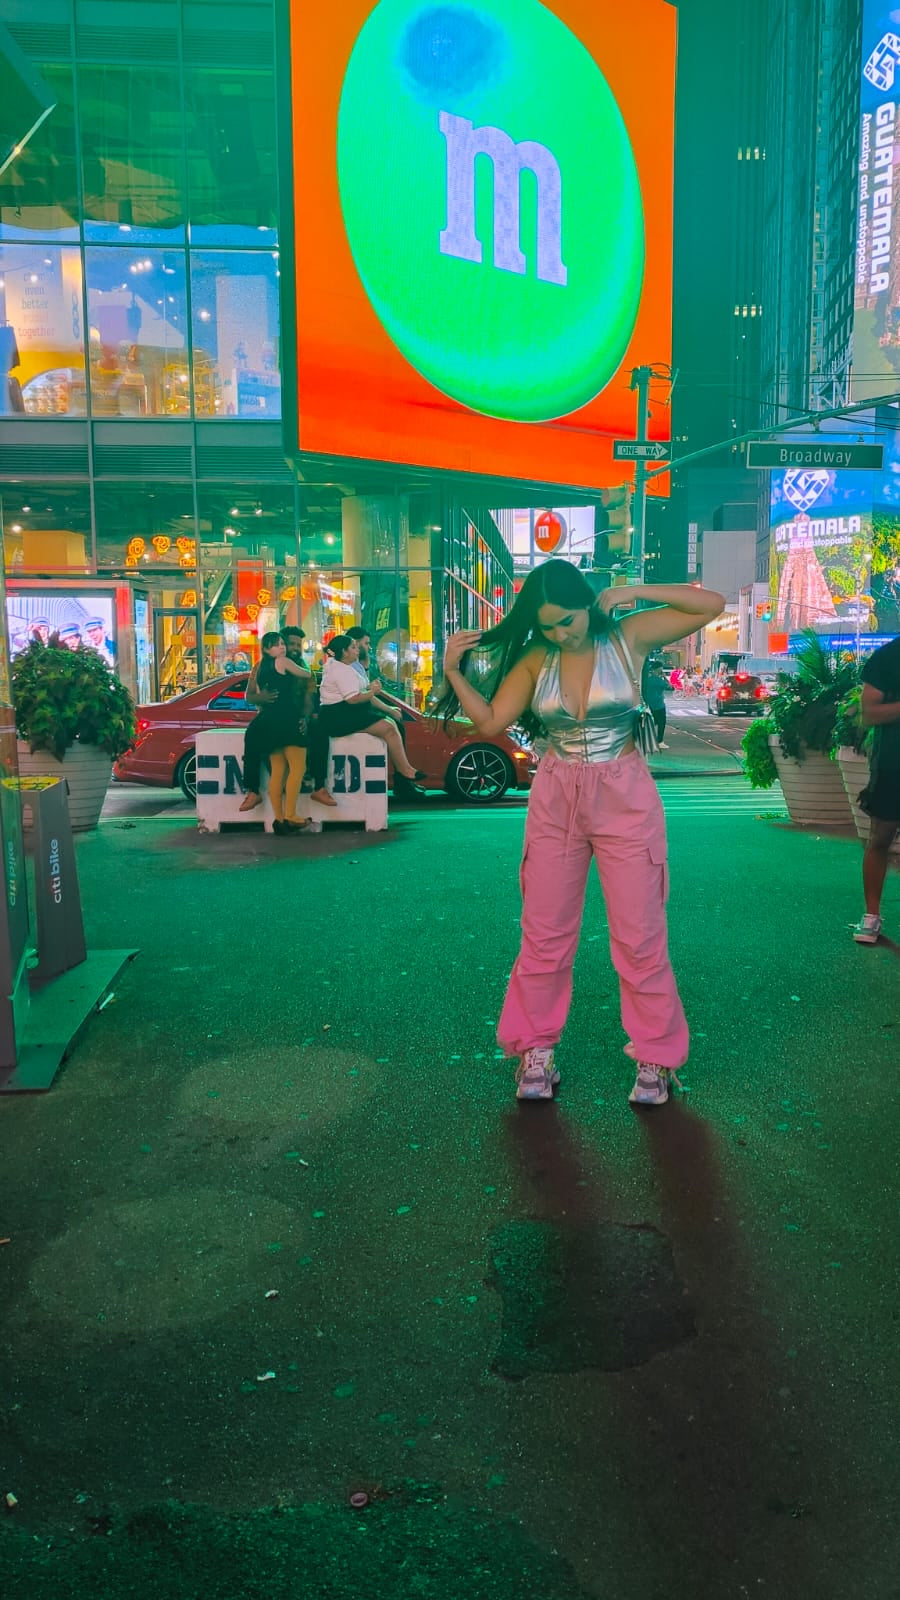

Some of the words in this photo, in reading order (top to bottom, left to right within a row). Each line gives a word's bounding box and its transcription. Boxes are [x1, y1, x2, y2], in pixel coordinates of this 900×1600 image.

[859, 113, 872, 171] Amazing
[438, 109, 567, 286] m
[860, 174, 869, 201] and
[871, 102, 895, 294] GUATEMALA
[857, 204, 868, 284] unstoppable
[622, 446, 638, 455] ONE
[645, 447, 662, 456] WAY
[780, 448, 851, 467] Broadway
[538, 525, 549, 538] m
[50, 839, 60, 875] bike
[52, 876, 62, 904] citi
